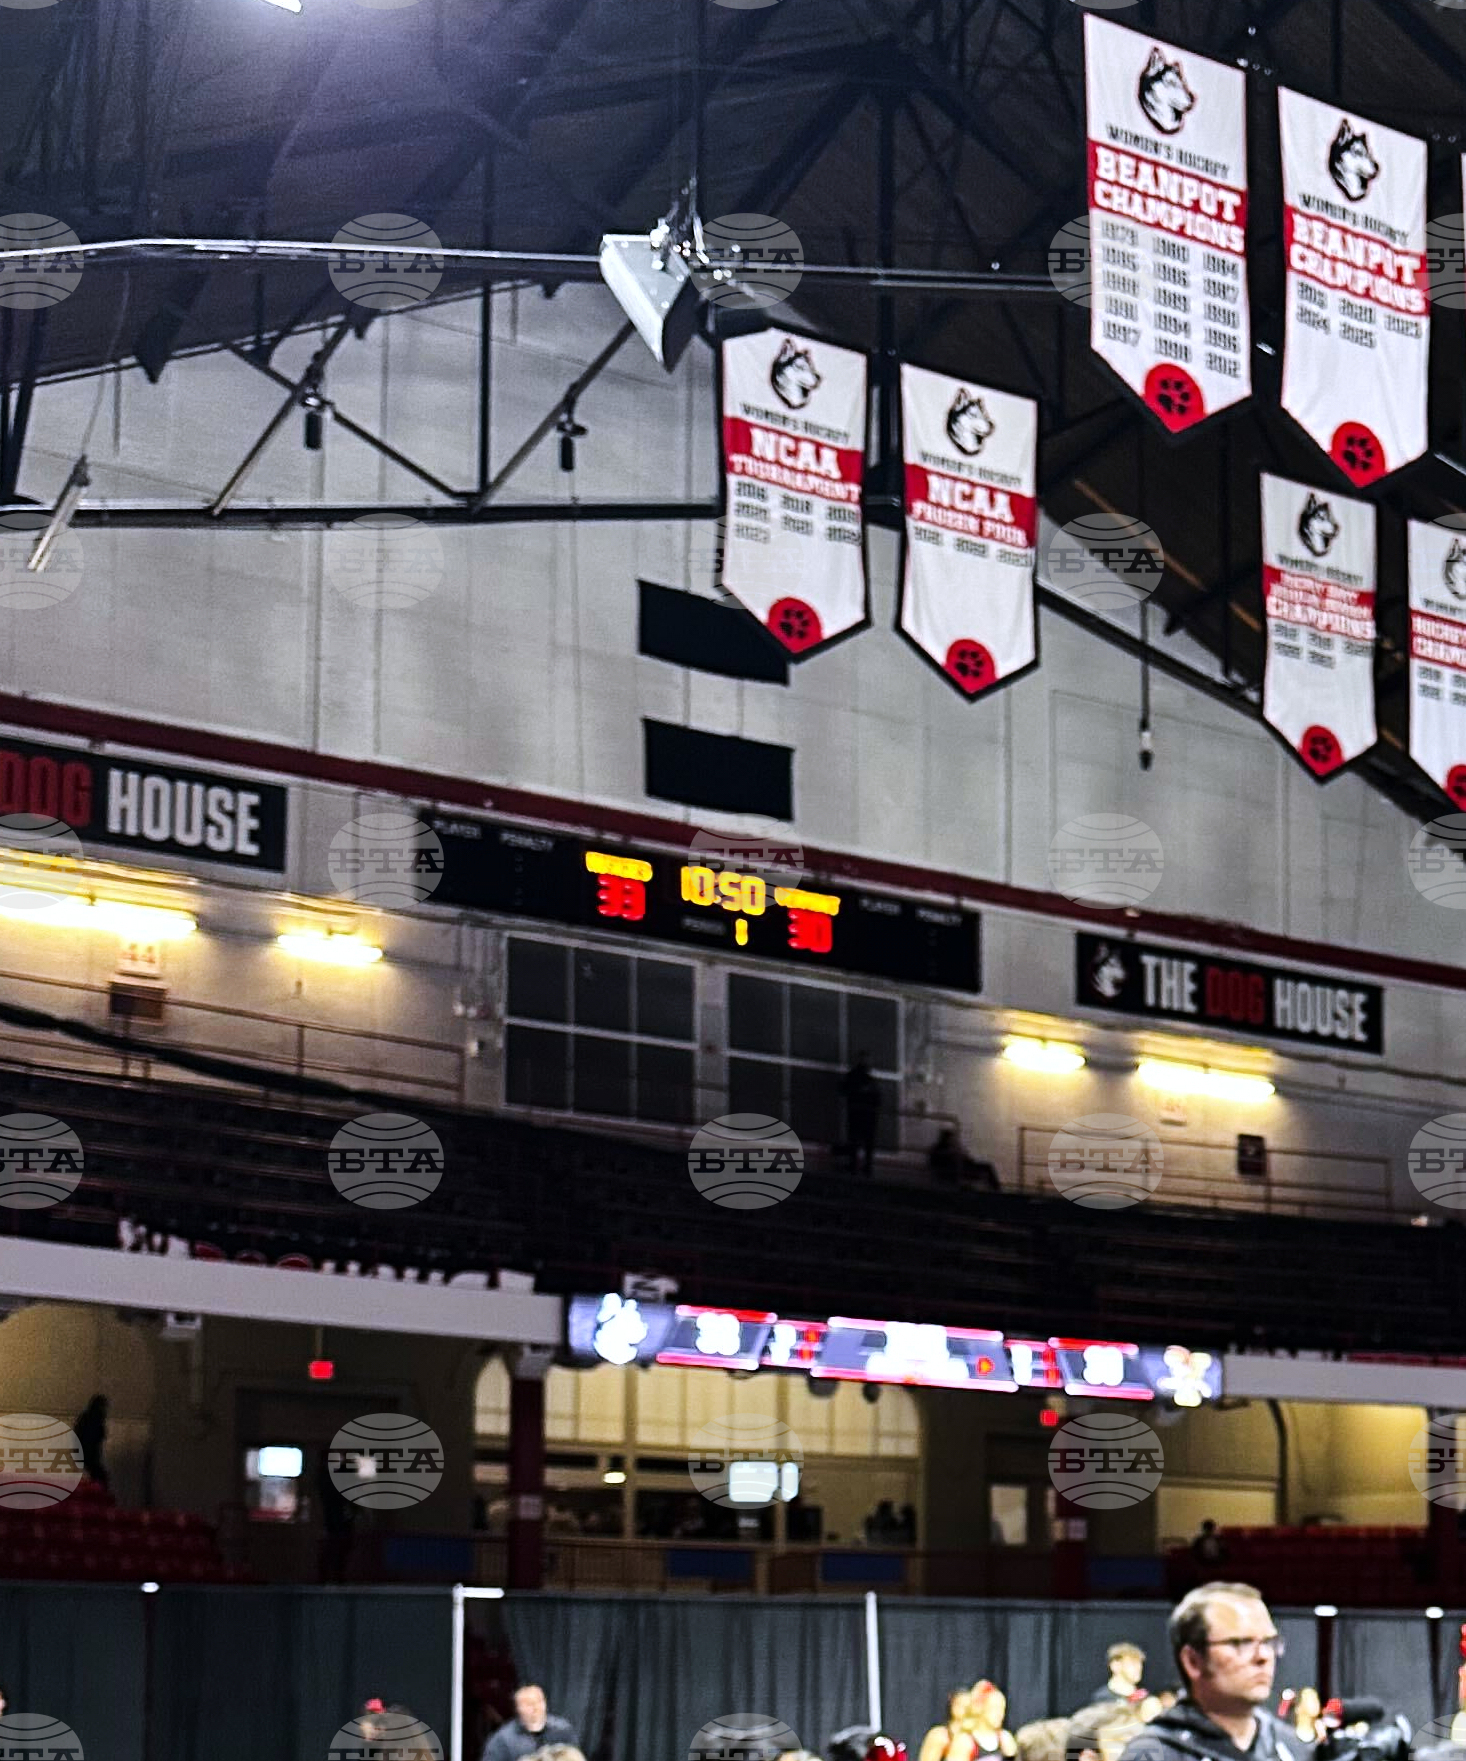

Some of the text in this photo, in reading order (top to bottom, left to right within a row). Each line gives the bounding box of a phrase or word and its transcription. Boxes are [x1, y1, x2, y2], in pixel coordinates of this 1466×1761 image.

[1094, 179, 1245, 253] CHAMPIONS
[1095, 145, 1242, 222] BEANPOT
[1290, 243, 1426, 315] CHAMPIONS
[1292, 210, 1421, 286] BEANPOT
[750, 427, 842, 480] NCAA
[927, 473, 1015, 524] NCAA
[107, 766, 261, 857] HOUSE
[1140, 952, 1368, 1043] THE DOG HOUSE
